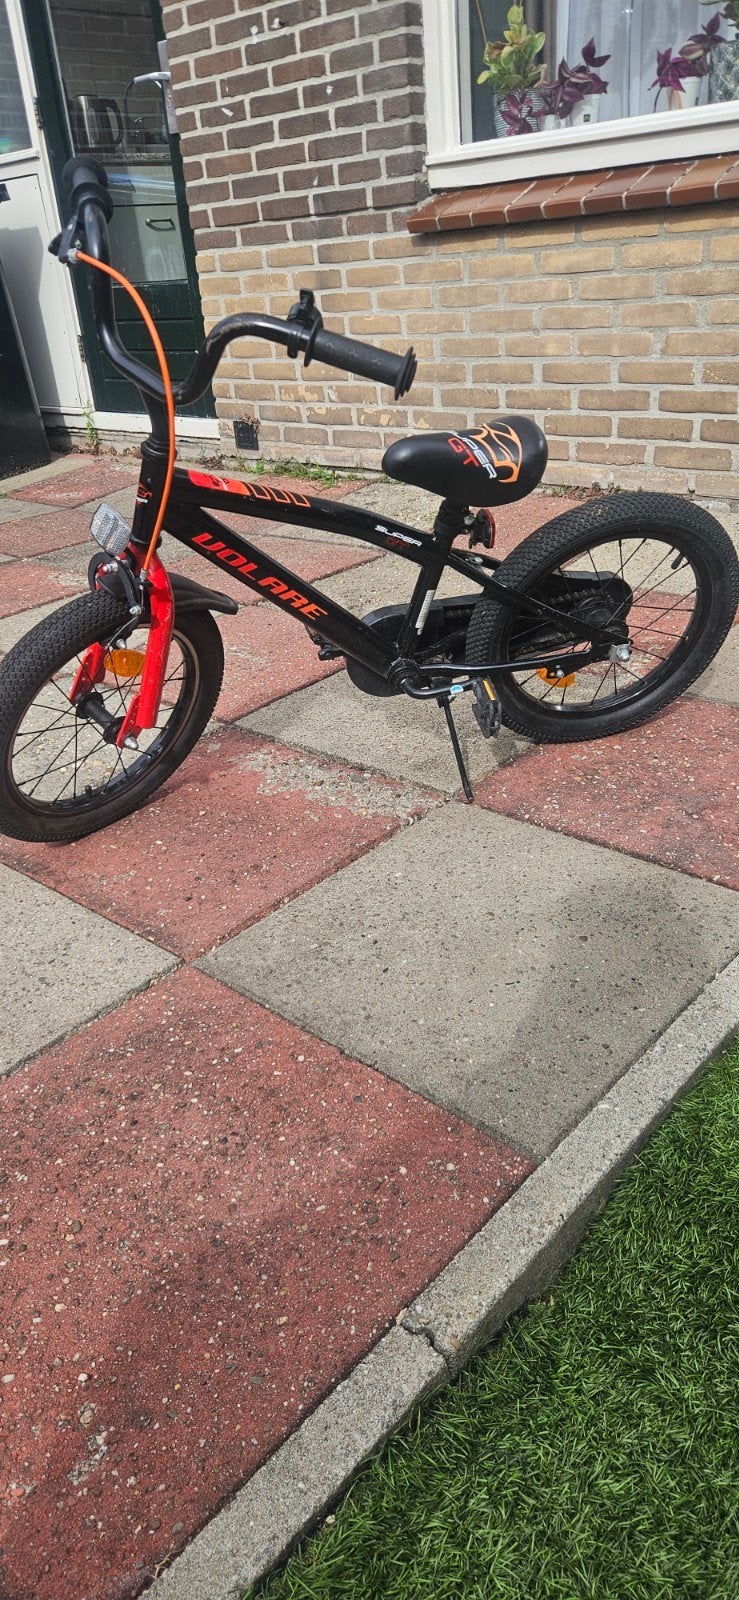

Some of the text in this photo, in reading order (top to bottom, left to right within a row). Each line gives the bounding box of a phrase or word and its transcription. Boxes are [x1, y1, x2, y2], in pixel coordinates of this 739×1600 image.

[448, 437, 480, 467] GT
[453, 431, 497, 479] UPER
[374, 524, 422, 547] SUPER
